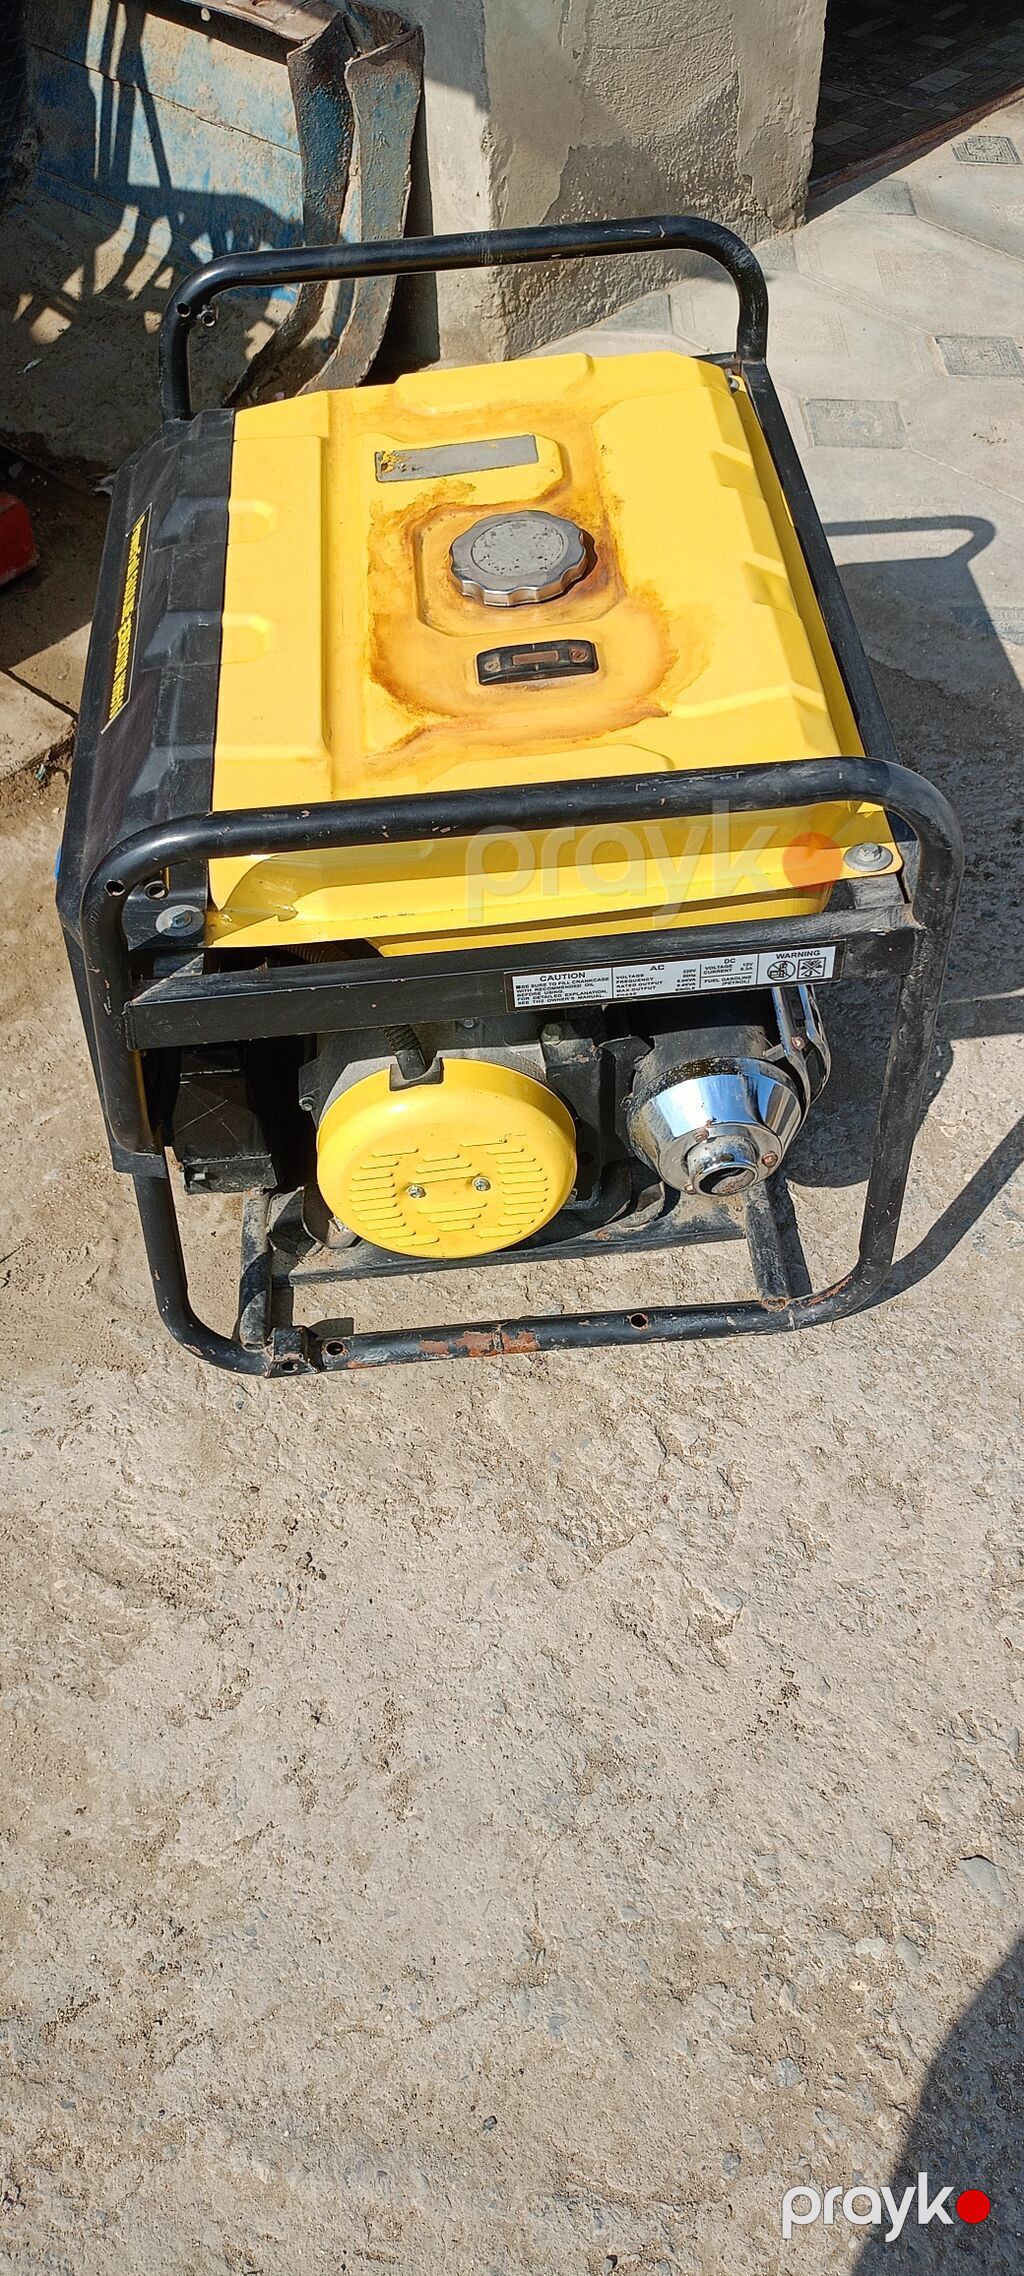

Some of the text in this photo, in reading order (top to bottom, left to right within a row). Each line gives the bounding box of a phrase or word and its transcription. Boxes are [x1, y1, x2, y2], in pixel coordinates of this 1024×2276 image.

[776, 950, 821, 960] WARNING
[540, 972, 585, 982] CAUTION
[534, 984, 582, 992] RECOMMENDED
